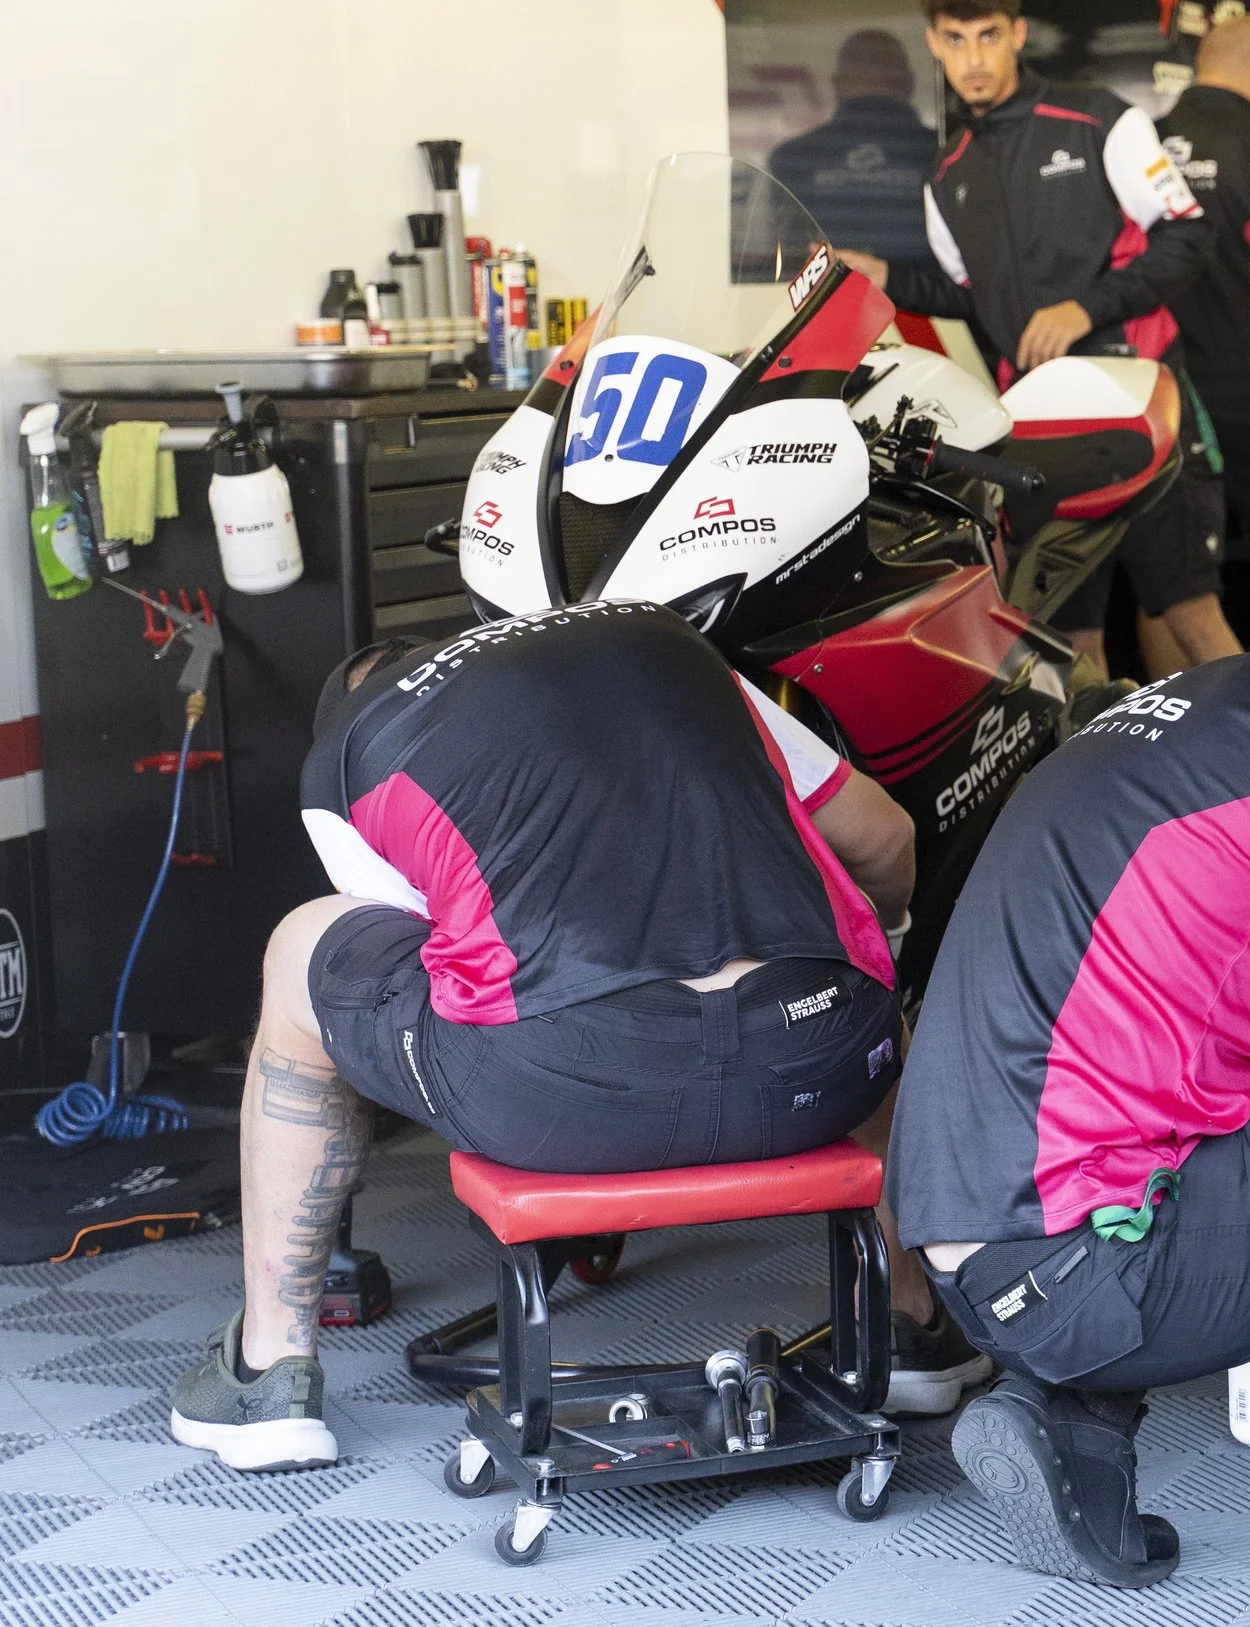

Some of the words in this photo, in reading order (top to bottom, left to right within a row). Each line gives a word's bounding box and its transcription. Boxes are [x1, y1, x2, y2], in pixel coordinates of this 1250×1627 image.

[790, 245, 828, 308] WRS
[564, 352, 707, 466] 50
[747, 454, 834, 465] RACING
[749, 443, 837, 456] TRIUMPH
[659, 517, 776, 551] COMPOS
[662, 536, 777, 561] DISTRIBUTION
[936, 710, 1031, 817] COMPOS
[787, 986, 838, 1013] ENGELBERT
[790, 1000, 832, 1021] STRAUSS
[996, 1299, 1025, 1322] STRAUSS
